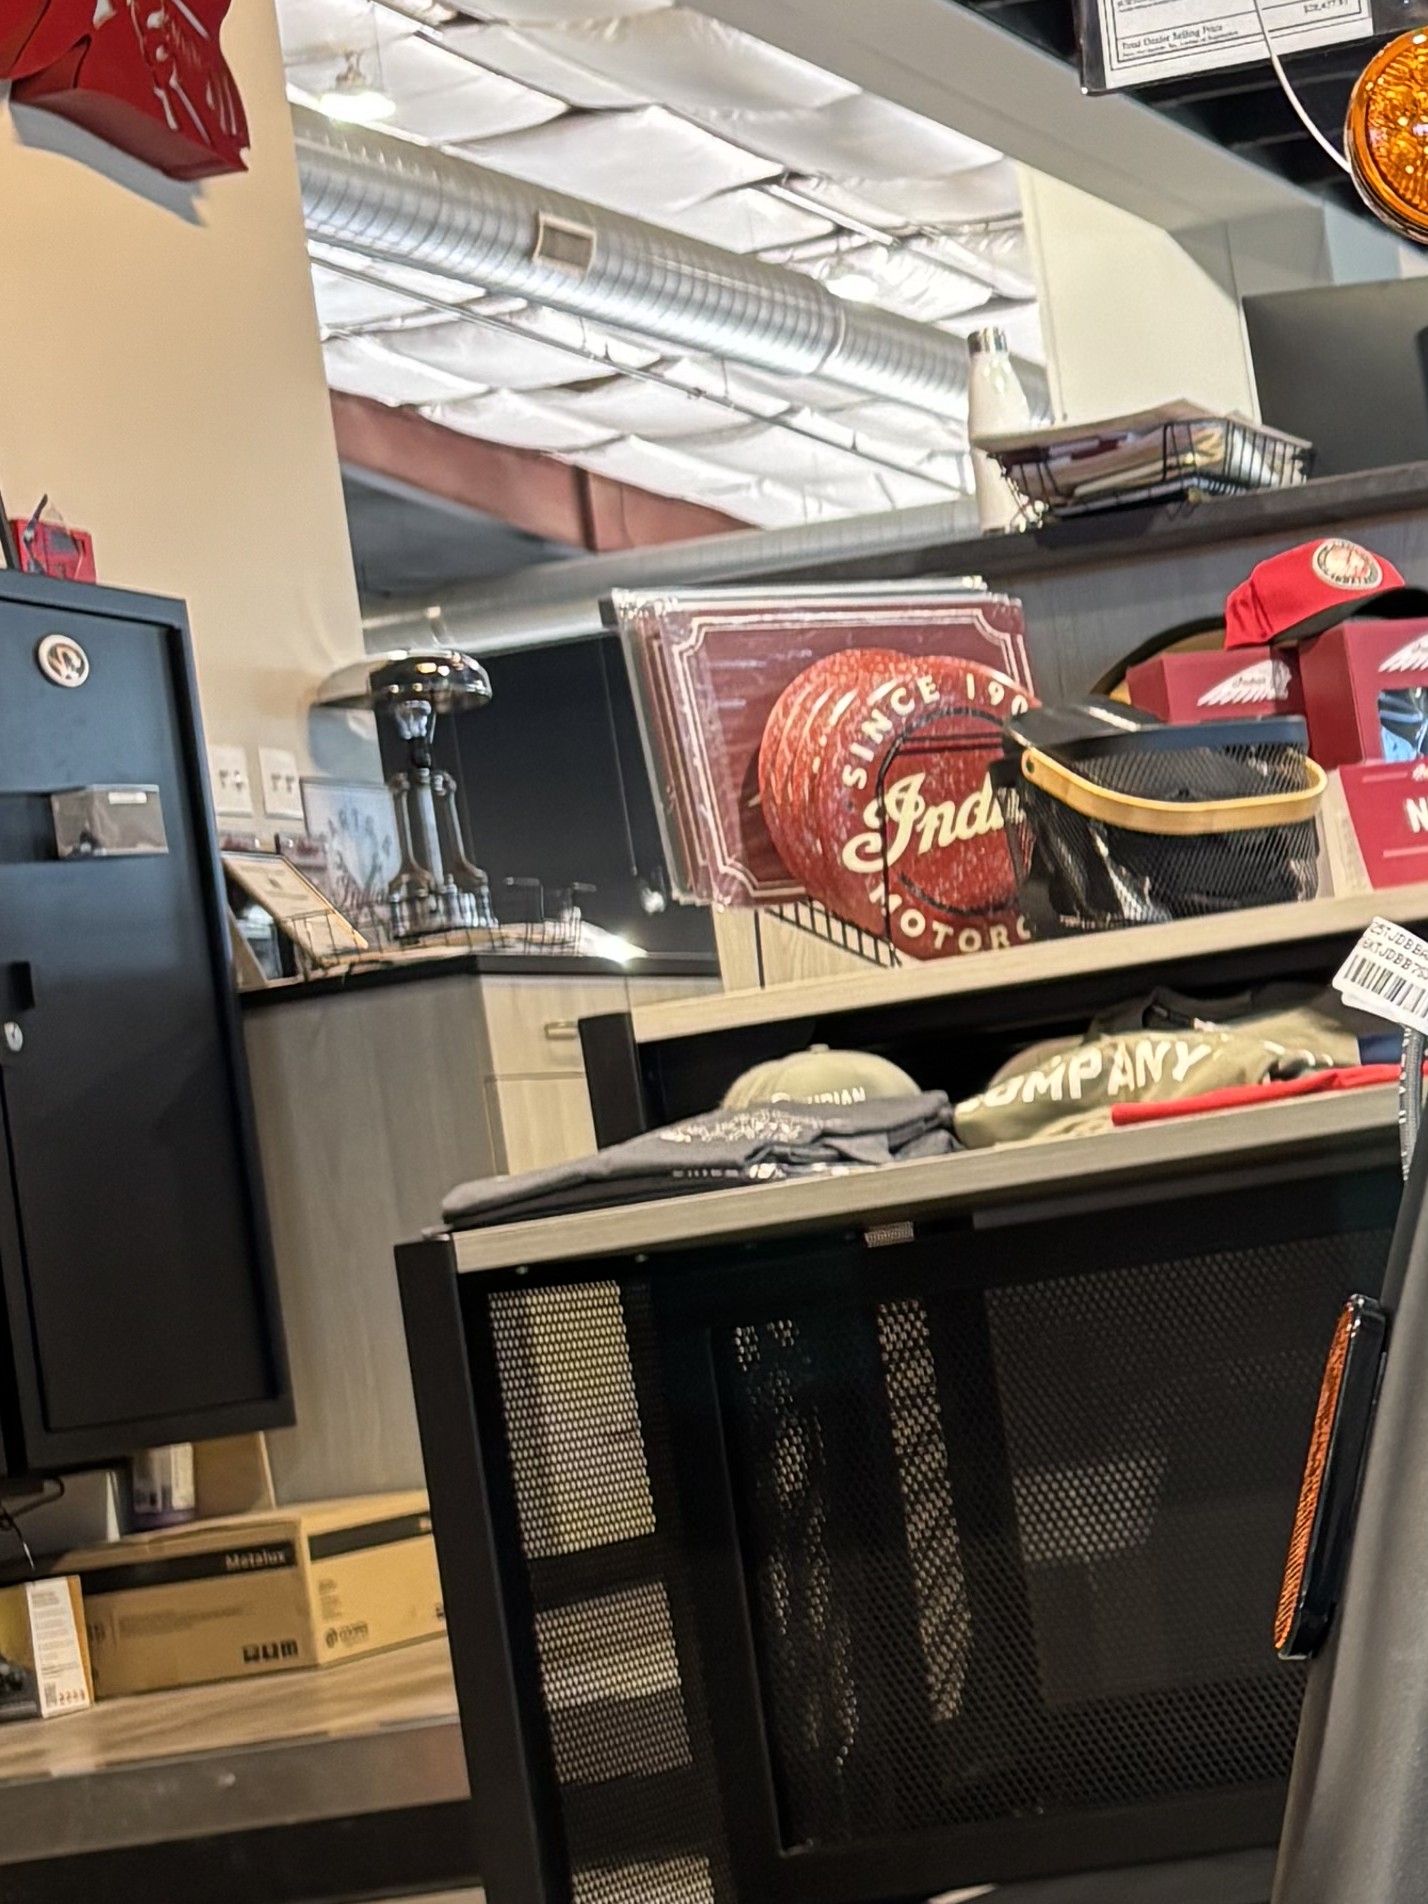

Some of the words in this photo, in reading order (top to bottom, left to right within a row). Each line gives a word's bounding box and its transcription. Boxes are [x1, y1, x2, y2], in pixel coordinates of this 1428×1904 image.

[842, 674, 941, 791] SINCE
[965, 672, 1029, 717] 190
[225, 1548, 286, 1571] Metalux
